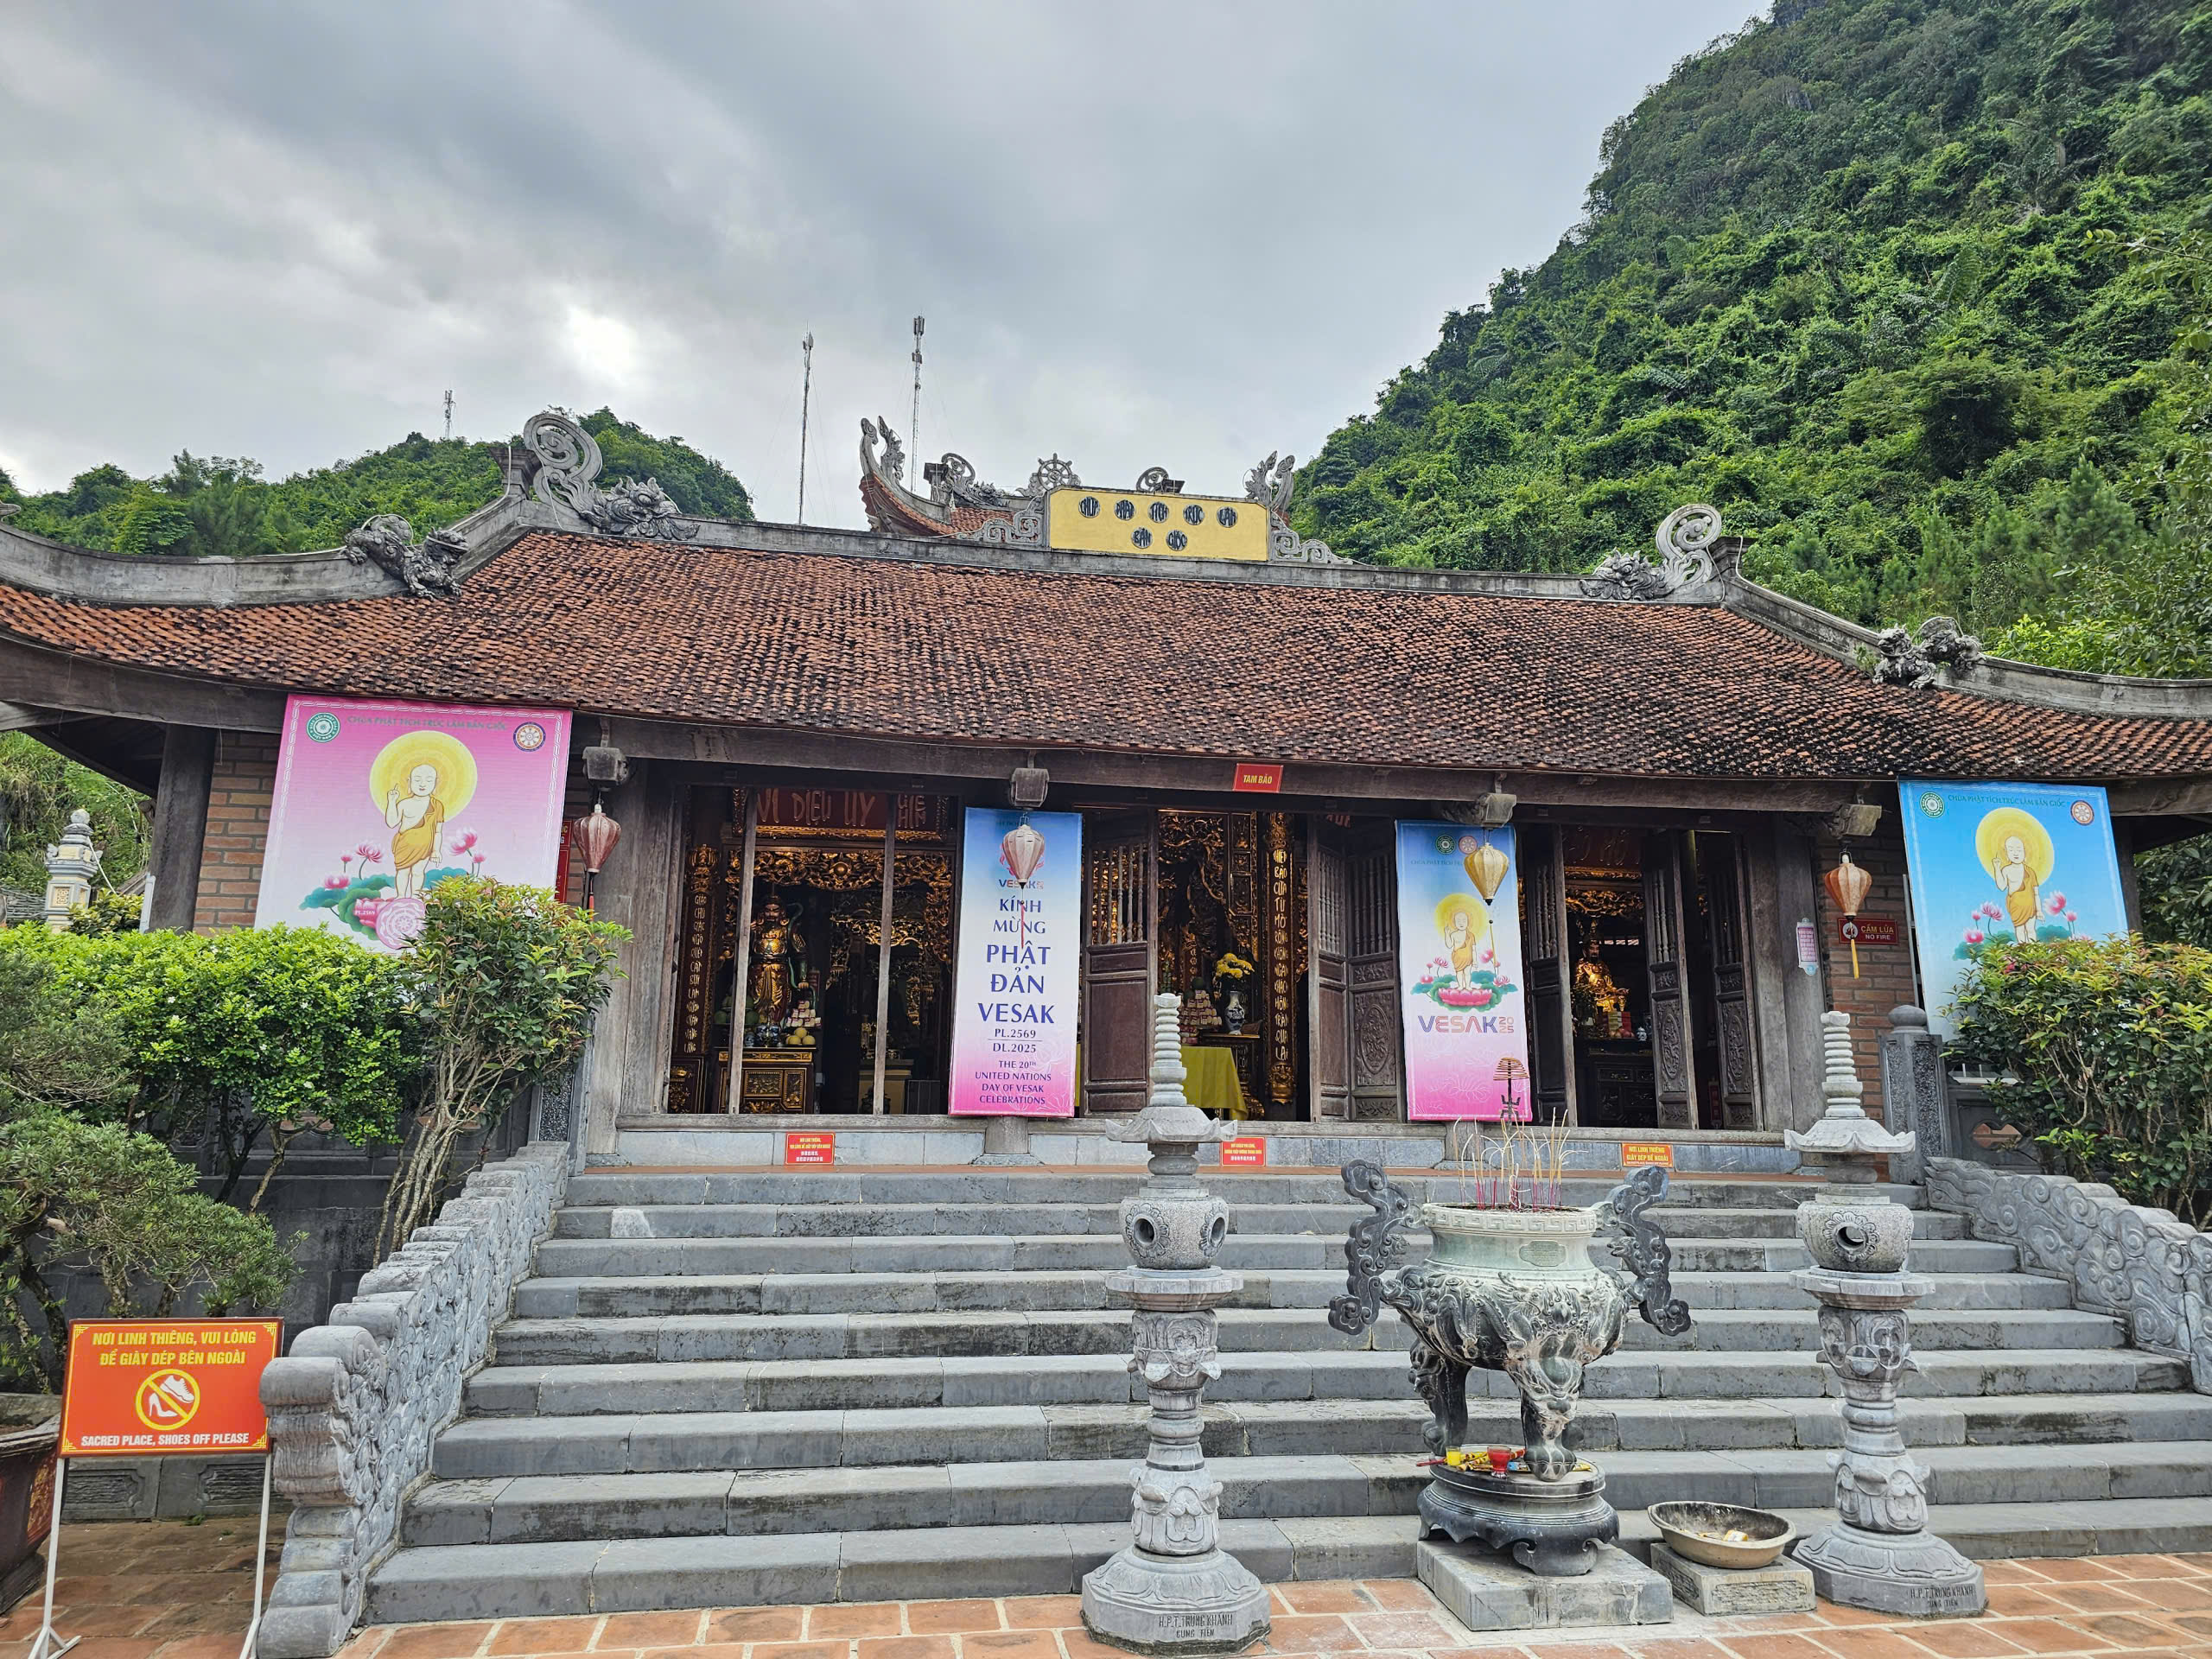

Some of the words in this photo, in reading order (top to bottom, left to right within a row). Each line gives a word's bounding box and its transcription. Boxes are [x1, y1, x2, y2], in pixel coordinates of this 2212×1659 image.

[1243, 774, 1257, 784] TAM
[1258, 773, 1273, 785] BẢO
[1000, 895, 1041, 912] KÍNH
[993, 916, 1046, 934] MỪNG
[1860, 923, 1878, 933] CẤM
[1878, 924, 1894, 933] LỬA
[987, 940, 1051, 969] PHẬT
[990, 966, 1044, 995] ĐẢN
[977, 1002, 1055, 1024] VESAK
[1417, 1015, 1498, 1033] VESAK
[995, 1028, 1037, 1039] PL.2569
[993, 1043, 1037, 1053] DL.2025
[999, 1060, 1017, 1069] THE
[975, 1071, 1010, 1080] UNITED
[1012, 1072, 1052, 1082] NATIONS
[982, 1084, 1001, 1092] DAY
[1002, 1084, 1014, 1092] OF
[1016, 1084, 1044, 1093] VESAK
[979, 1095, 1046, 1105] CELEBRATIONS
[92, 1332, 115, 1345] NƠI
[118, 1332, 147, 1344] LINH
[150, 1330, 197, 1346] THIÊNG,
[200, 1332, 221, 1344] VUI
[224, 1329, 257, 1344] LÒNG
[99, 1349, 118, 1365] ĐỂ
[119, 1351, 149, 1366] GIÀY
[151, 1350, 175, 1365] DÉP
[178, 1349, 204, 1364] BÊN
[207, 1349, 245, 1364] NGOÀI
[81, 1435, 119, 1446] SACRED
[121, 1435, 156, 1446] PLACE,
[158, 1433, 190, 1445] SHOES
[193, 1433, 211, 1445] OFF
[212, 1433, 251, 1444] PLEASE
[1206, 1611, 1233, 1627] KHÁNH
